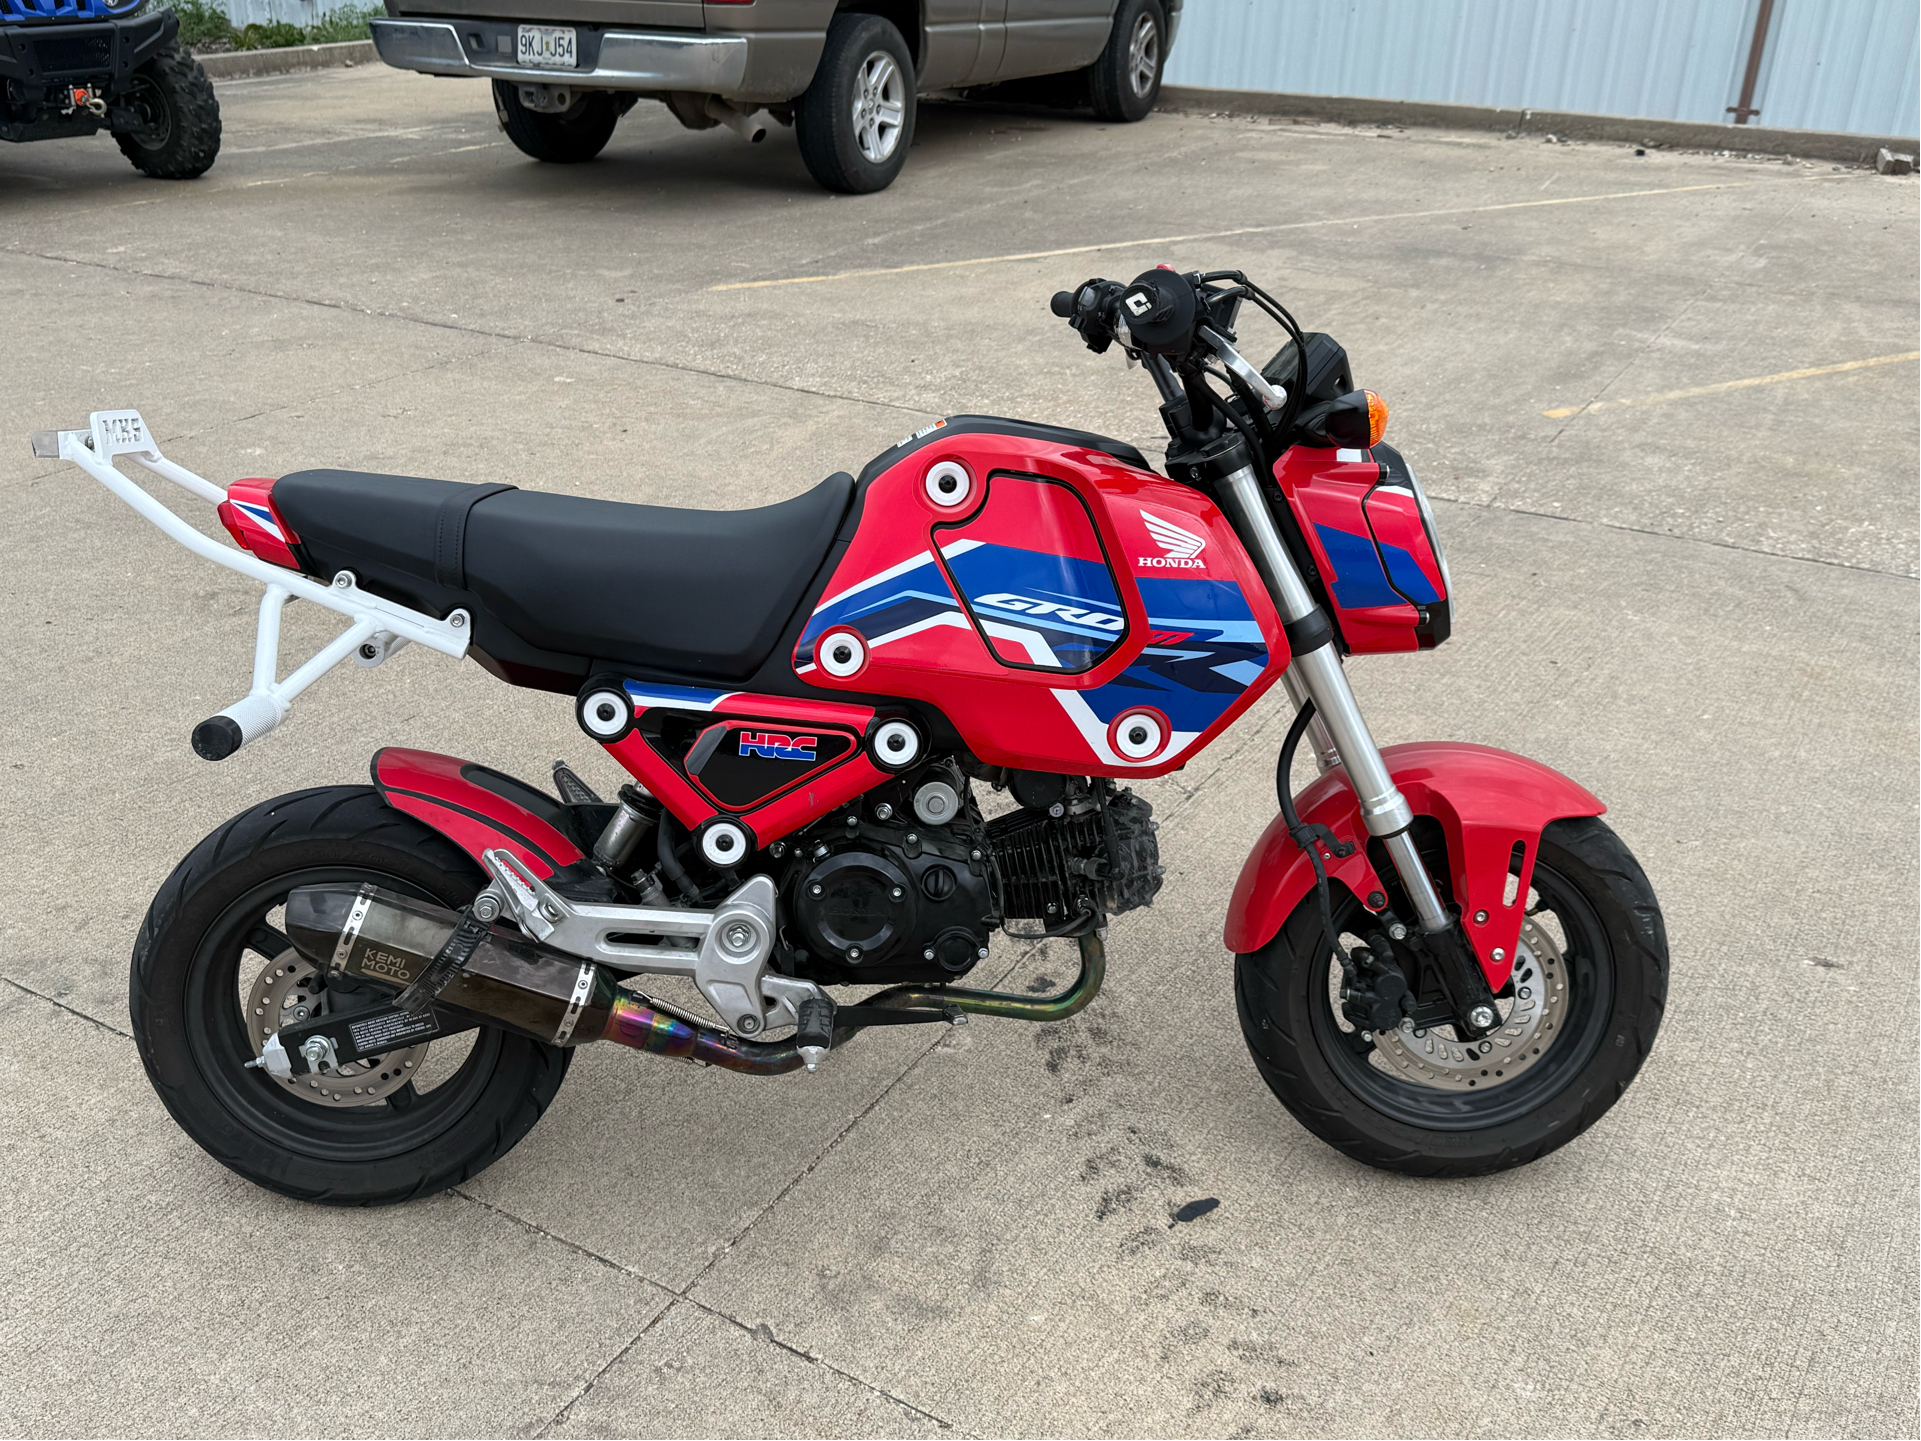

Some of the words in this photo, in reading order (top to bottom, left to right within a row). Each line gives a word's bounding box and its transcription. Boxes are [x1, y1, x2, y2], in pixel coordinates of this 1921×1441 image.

[520, 34, 543, 56] 9KJ
[550, 36, 573, 58] J54
[1137, 557, 1206, 569] HONDA
[739, 731, 817, 761] HRC
[361, 958, 410, 979] MOTO
[364, 948, 406, 969] KEMI
